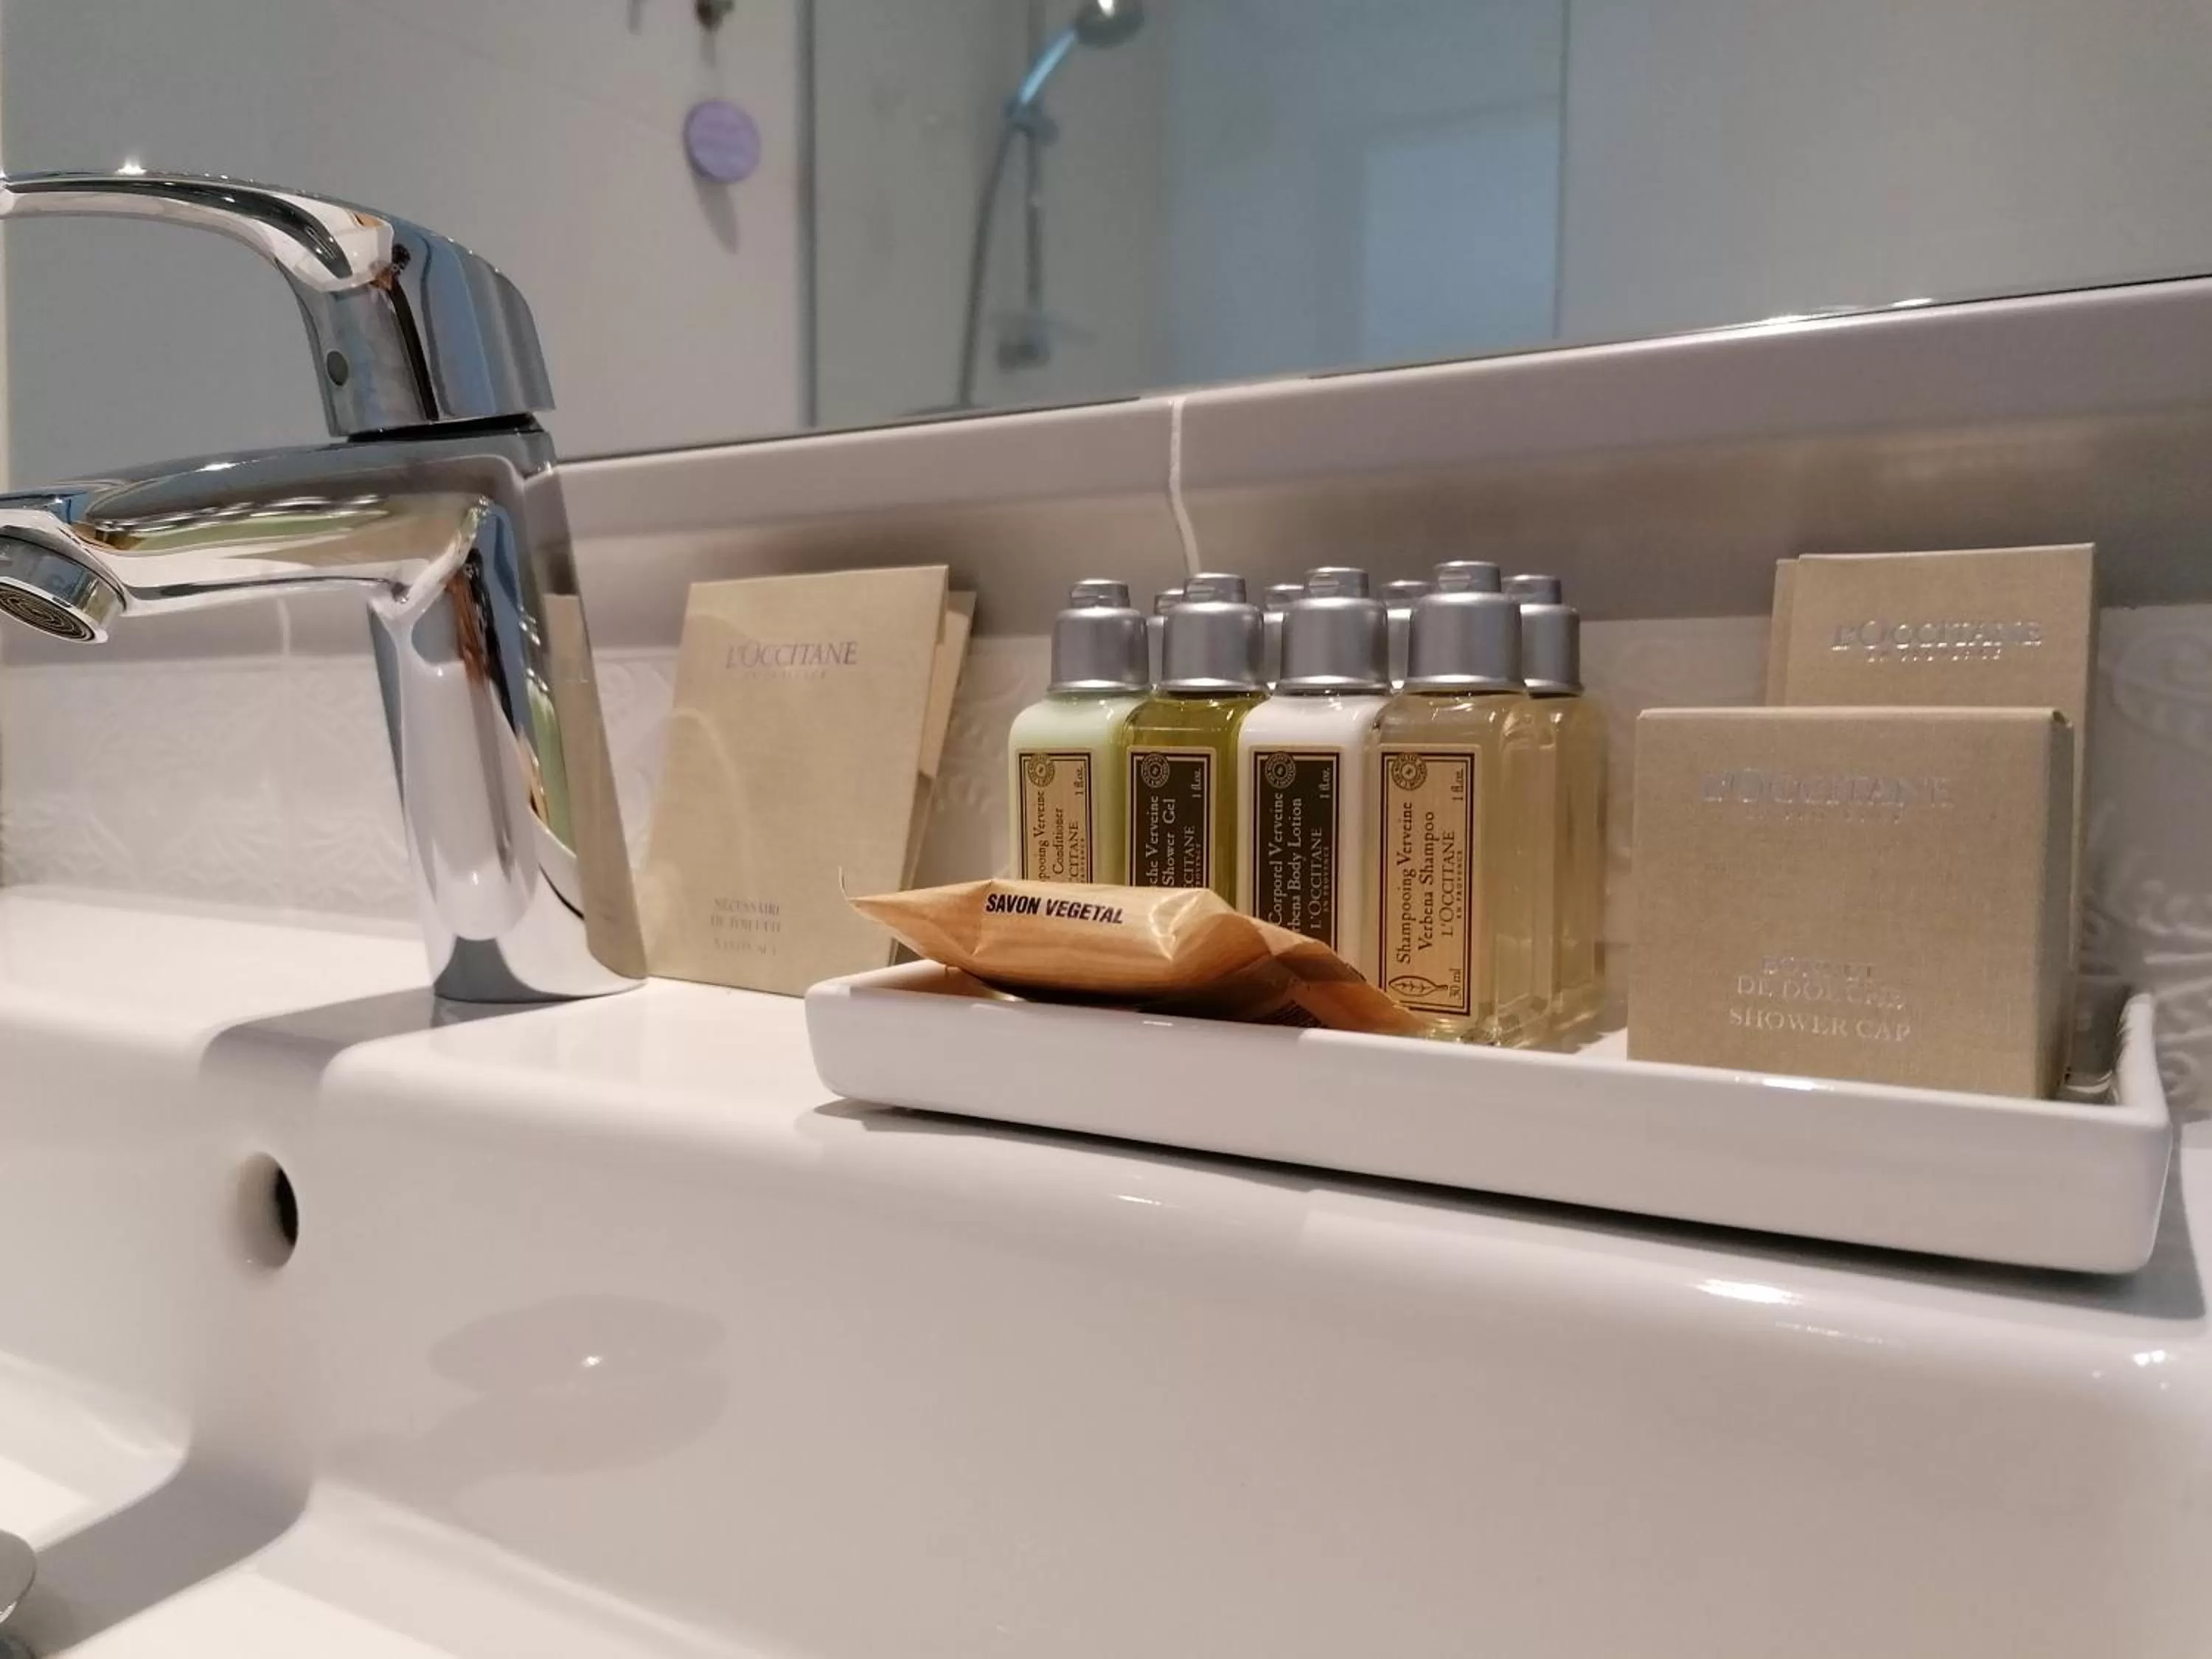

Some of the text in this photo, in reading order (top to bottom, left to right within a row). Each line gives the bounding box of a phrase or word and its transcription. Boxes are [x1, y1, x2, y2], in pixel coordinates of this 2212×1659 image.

[725, 639, 859, 669] L'OCCITANE
[1033, 790, 1046, 838] Verveine
[1052, 807, 1064, 874] Conditioner
[1145, 796, 1158, 857] Verveine
[1162, 797, 1177, 886] Shower Gel
[1268, 793, 1284, 858] Verveine
[1396, 801, 1413, 867] Verveine
[1145, 860, 1159, 886] che
[1267, 860, 1287, 927] Corporel
[1287, 798, 1307, 934] rbena Body Lotion
[1307, 827, 1322, 929] L'OCCITANE
[1418, 811, 1439, 950] Verbena Shampoo
[1439, 830, 1455, 938] L'OCCITANE
[986, 893, 1124, 924] SAVON VEGETAL
[1396, 869, 1416, 964] Shampooing
[1448, 968, 1462, 1001] 30 ml
[1736, 975, 1773, 998] DE
[1729, 1006, 1911, 1042] SHOWER CAP
